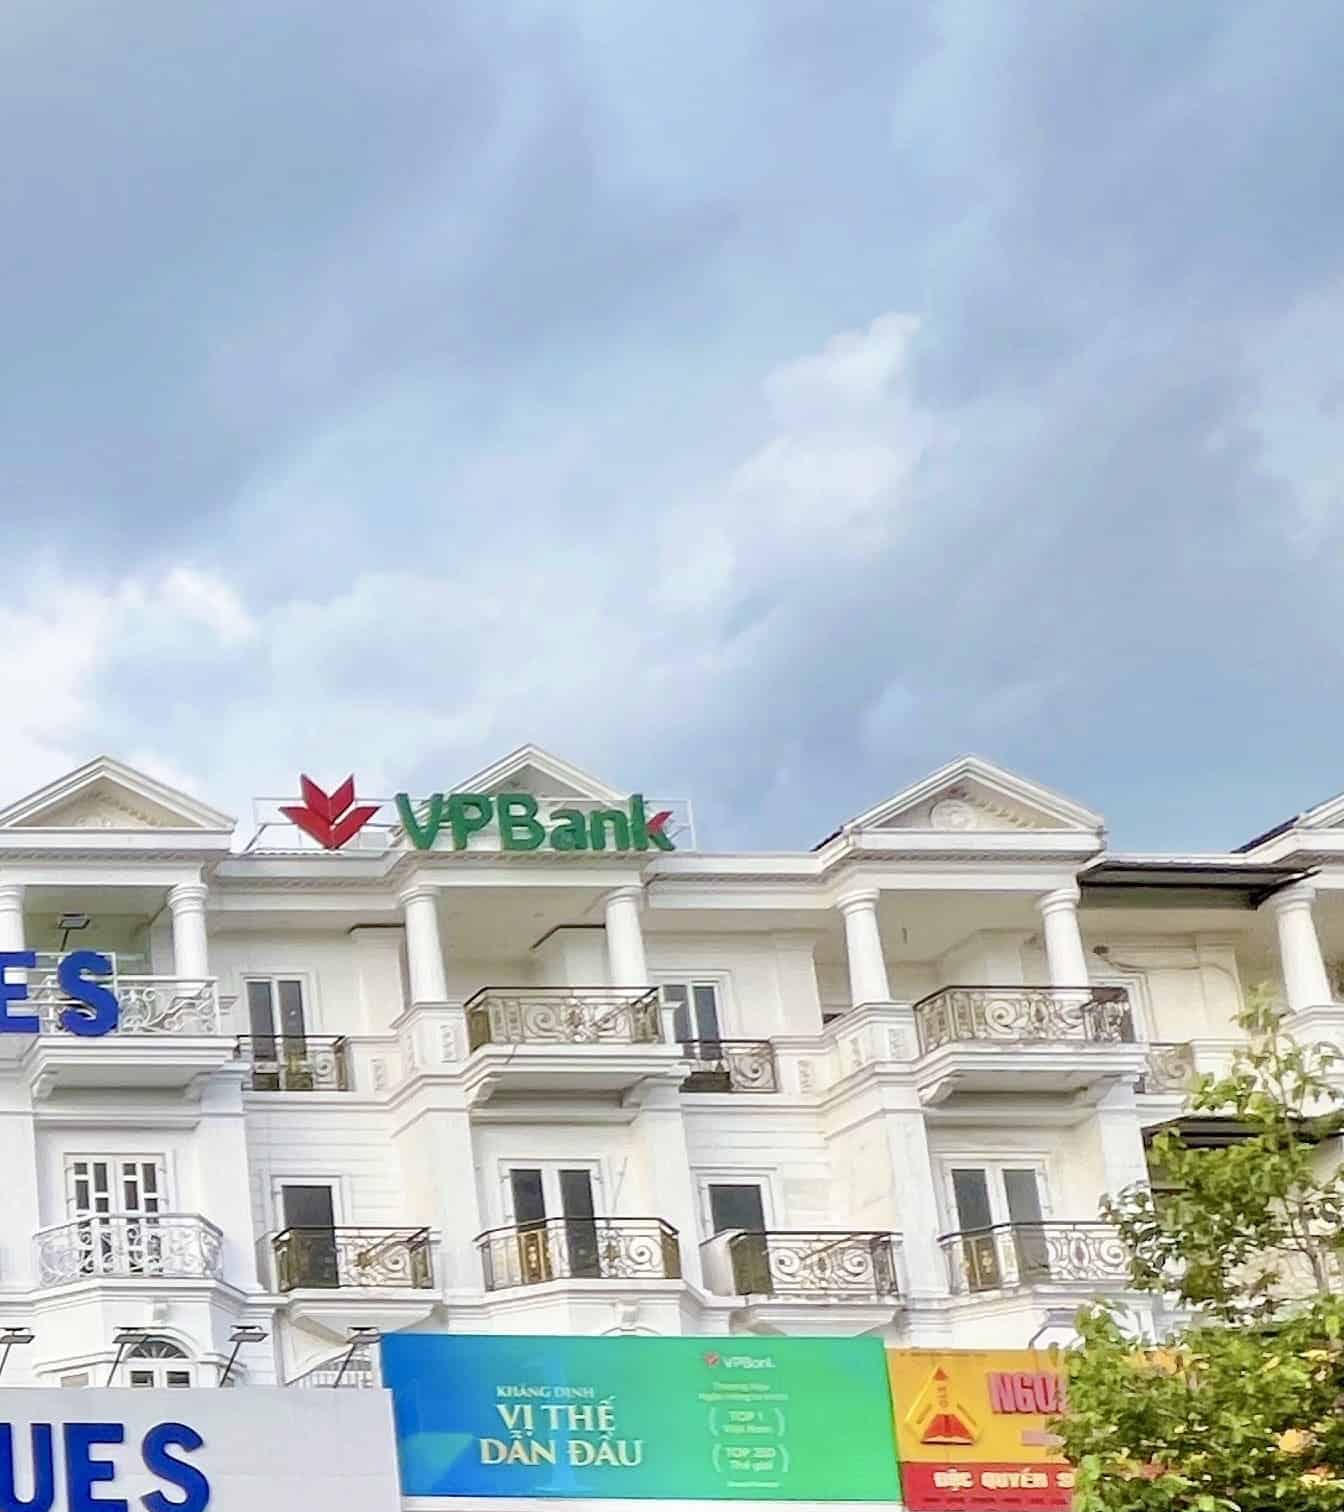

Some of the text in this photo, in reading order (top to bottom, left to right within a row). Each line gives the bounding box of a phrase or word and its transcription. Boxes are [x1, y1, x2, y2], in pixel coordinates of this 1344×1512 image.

[395, 792, 676, 852] VPBank
[540, 1395, 617, 1432] THẾ
[479, 1430, 644, 1467] DẪN ĐẦU
